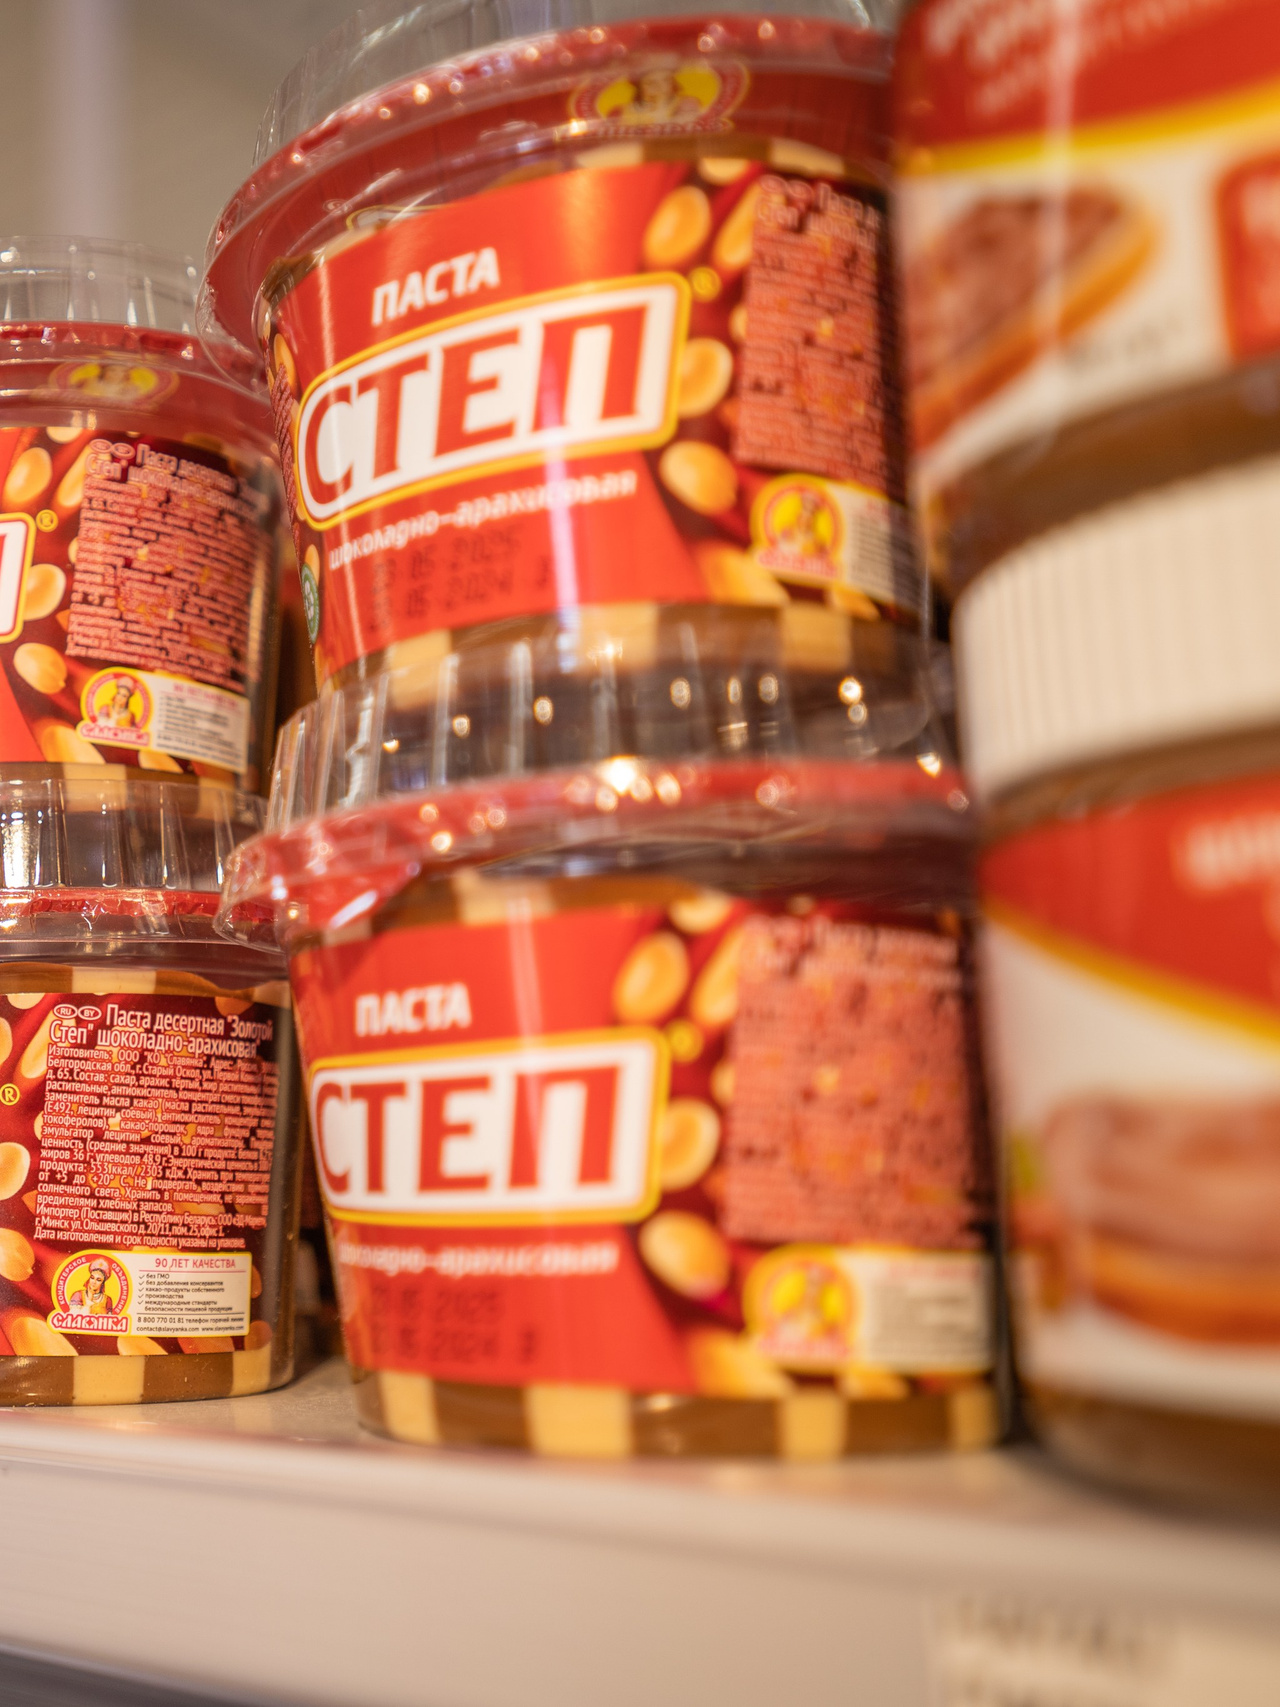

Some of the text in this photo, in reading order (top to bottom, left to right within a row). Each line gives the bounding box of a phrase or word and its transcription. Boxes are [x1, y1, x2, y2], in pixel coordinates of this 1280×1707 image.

[372, 247, 500, 326] ПАСТА
[304, 304, 649, 509] СТЕП
[355, 983, 470, 1036] ПАСТА
[106, 1004, 151, 1028] Паста
[154, 1013, 225, 1037] десертная
[50, 1020, 261, 1059] Степ" шоколадно-арахисовая"
[49, 1044, 112, 1060] Изготовитель:
[118, 1050, 139, 1062] ООО
[48, 1056, 112, 1071] Белгородская
[143, 1063, 174, 1077] Старый
[46, 1070, 55, 1079] д.
[57, 1068, 72, 1080] 65.
[73, 1069, 108, 1082] Состав:
[110, 1074, 138, 1086] сахар,
[139, 1076, 170, 1090] арахис
[46, 1081, 110, 1095] растительные,
[111, 1085, 177, 1099] антиокислитель
[45, 1092, 100, 1105] заменитель
[102, 1096, 130, 1107] масла
[133, 1099, 158, 1108] какао
[162, 1100, 189, 1111] (масла
[77, 1106, 116, 1117] лецитин
[43, 1115, 109, 1129] токоферолов),
[120, 1121, 187, 1136] какао-порошок,
[316, 1065, 620, 1197] СТЕП
[42, 1126, 94, 1139] эмульгатор
[104, 1130, 140, 1142] лецитин
[151, 1133, 183, 1145] соевый,
[40, 1149, 70, 1160] жиров
[72, 1149, 84, 1161] 36
[95, 1155, 140, 1165] углеводов
[42, 1138, 84, 1149] ценность
[86, 1140, 127, 1152] (средние
[129, 1142, 172, 1154] значения)
[173, 1147, 179, 1156] в
[181, 1145, 197, 1157] 100
[40, 1161, 87, 1173] продукта:
[90, 1162, 107, 1173] 553
[140, 1165, 163, 1176] 2303
[39, 1172, 49, 1181] от
[56, 1172, 67, 1183] +5
[73, 1174, 85, 1185] до
[135, 1177, 146, 1186] Не
[38, 1183, 90, 1196] солнечного
[95, 1187, 121, 1197] света.
[125, 1187, 161, 1199] Хранить
[164, 1192, 169, 1200] в
[37, 1195, 174, 1212] вредителями хлебных запасов.
[36, 1204, 79, 1220] Импортер
[81, 1208, 132, 1224] (Поставщик)
[140, 1211, 184, 1226] Республику
[42, 1216, 68, 1228] Минск
[71, 1220, 82, 1231] ул.
[83, 1219, 138, 1233] Ольшевского
[34, 1227, 55, 1239] Дата
[57, 1230, 114, 1243] изготовления
[123, 1233, 141, 1246] срок
[144, 1237, 177, 1249] годности
[155, 1258, 236, 1268] 90 ЛЕТ КАЧЕСТВА
[58, 1257, 128, 1313] КОНДИТЕРСКОЕ ОБЪЕДИНЕНИЕ
[51, 1313, 128, 1332] СЛАВЯНКА
